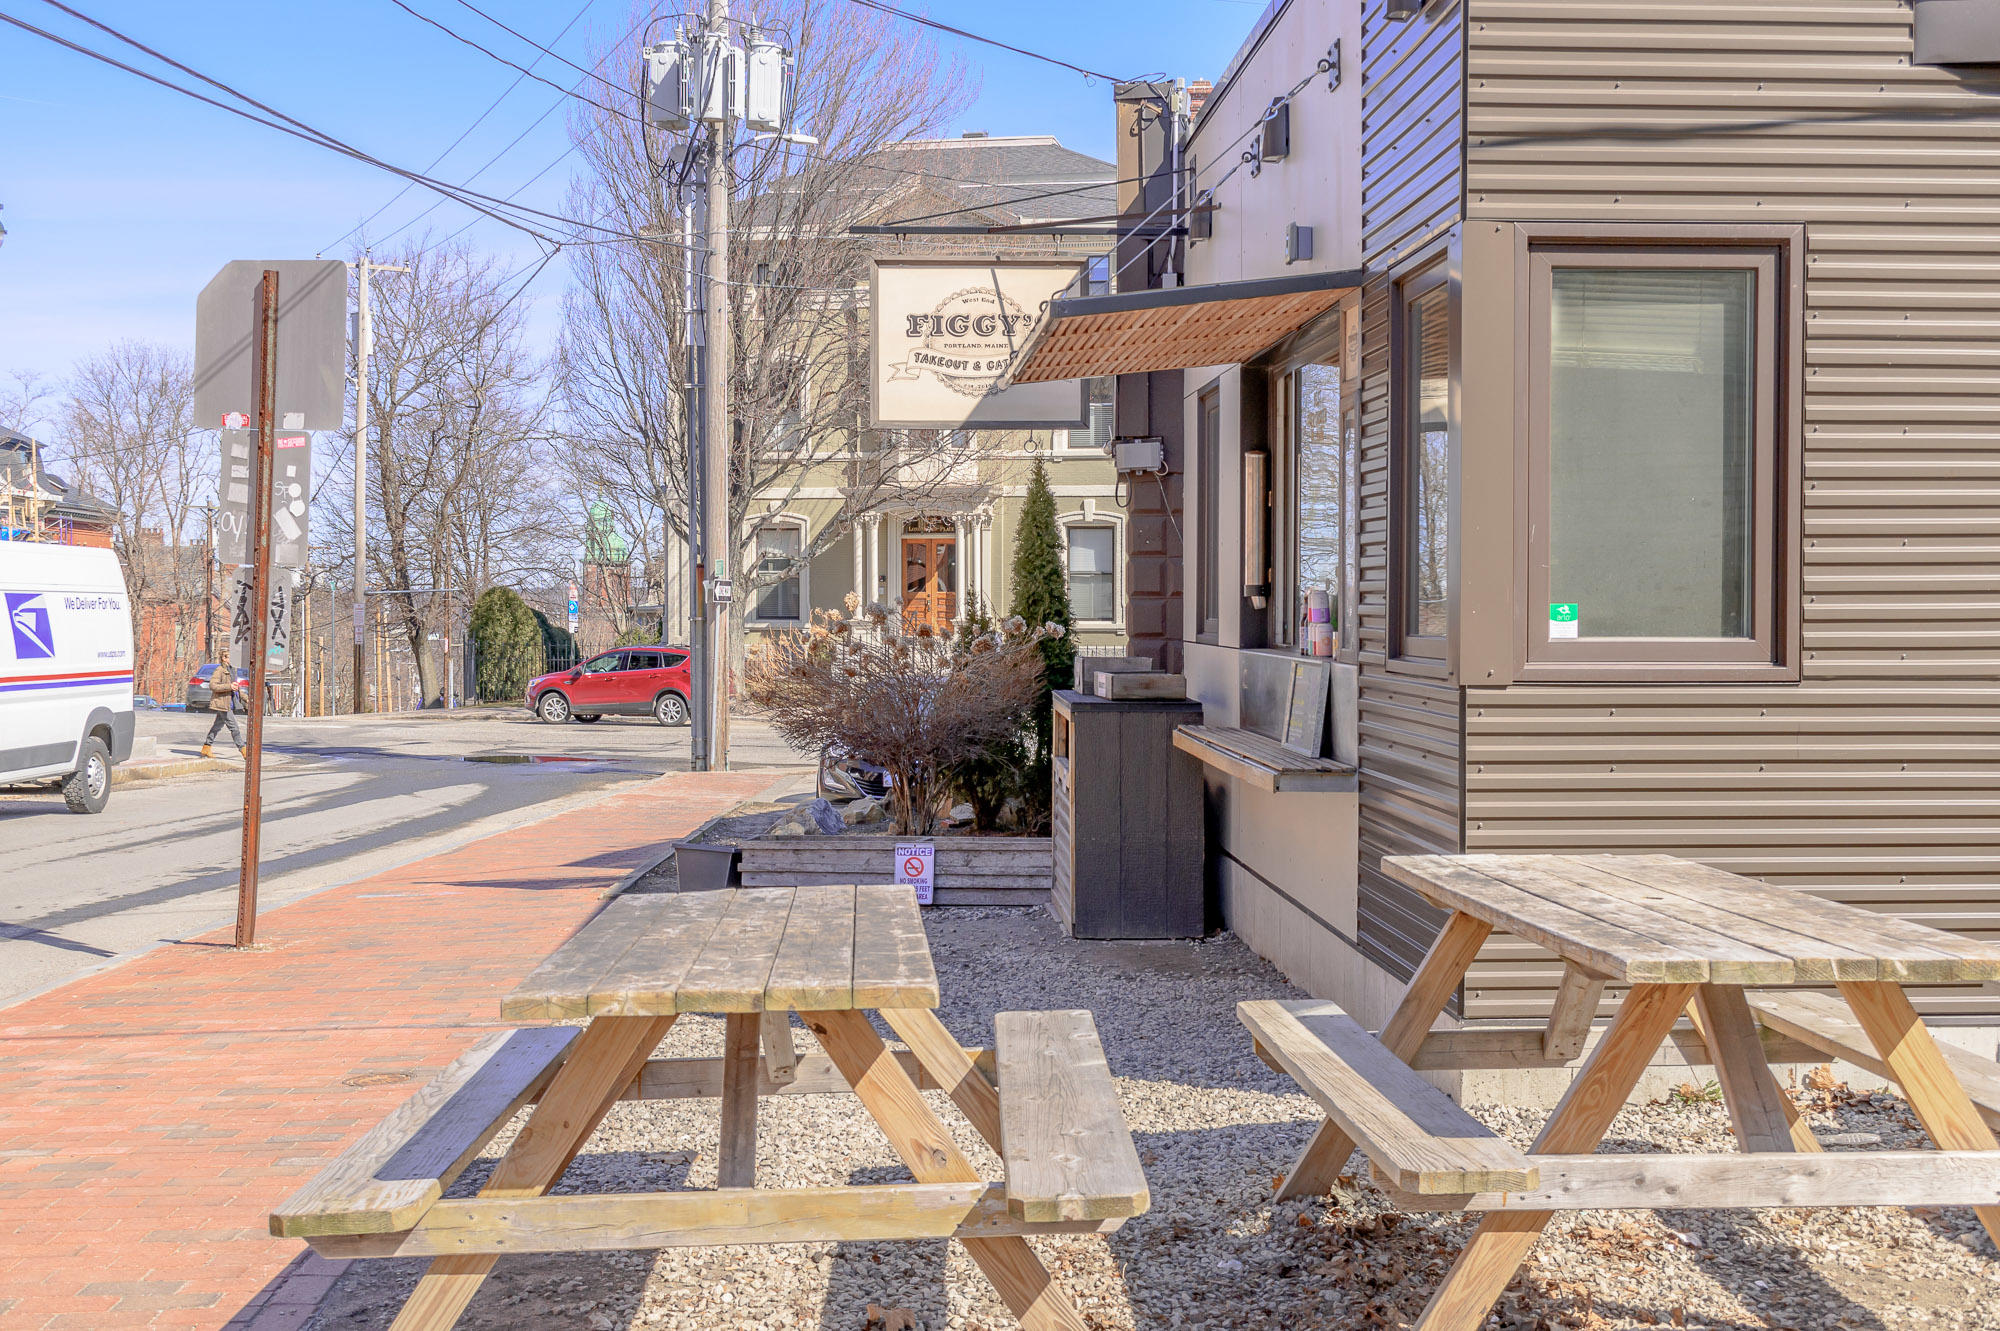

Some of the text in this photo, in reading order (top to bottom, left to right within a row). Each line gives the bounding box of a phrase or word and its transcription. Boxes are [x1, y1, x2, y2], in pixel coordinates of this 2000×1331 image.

[906, 314, 1042, 338] FIGGY'
[914, 352, 969, 371] TAKEOUT
[972, 360, 982, 371] &
[64, 597, 75, 610] We
[76, 597, 97, 610] Deliver
[98, 597, 108, 610] For
[898, 848, 932, 856] NOTICE
